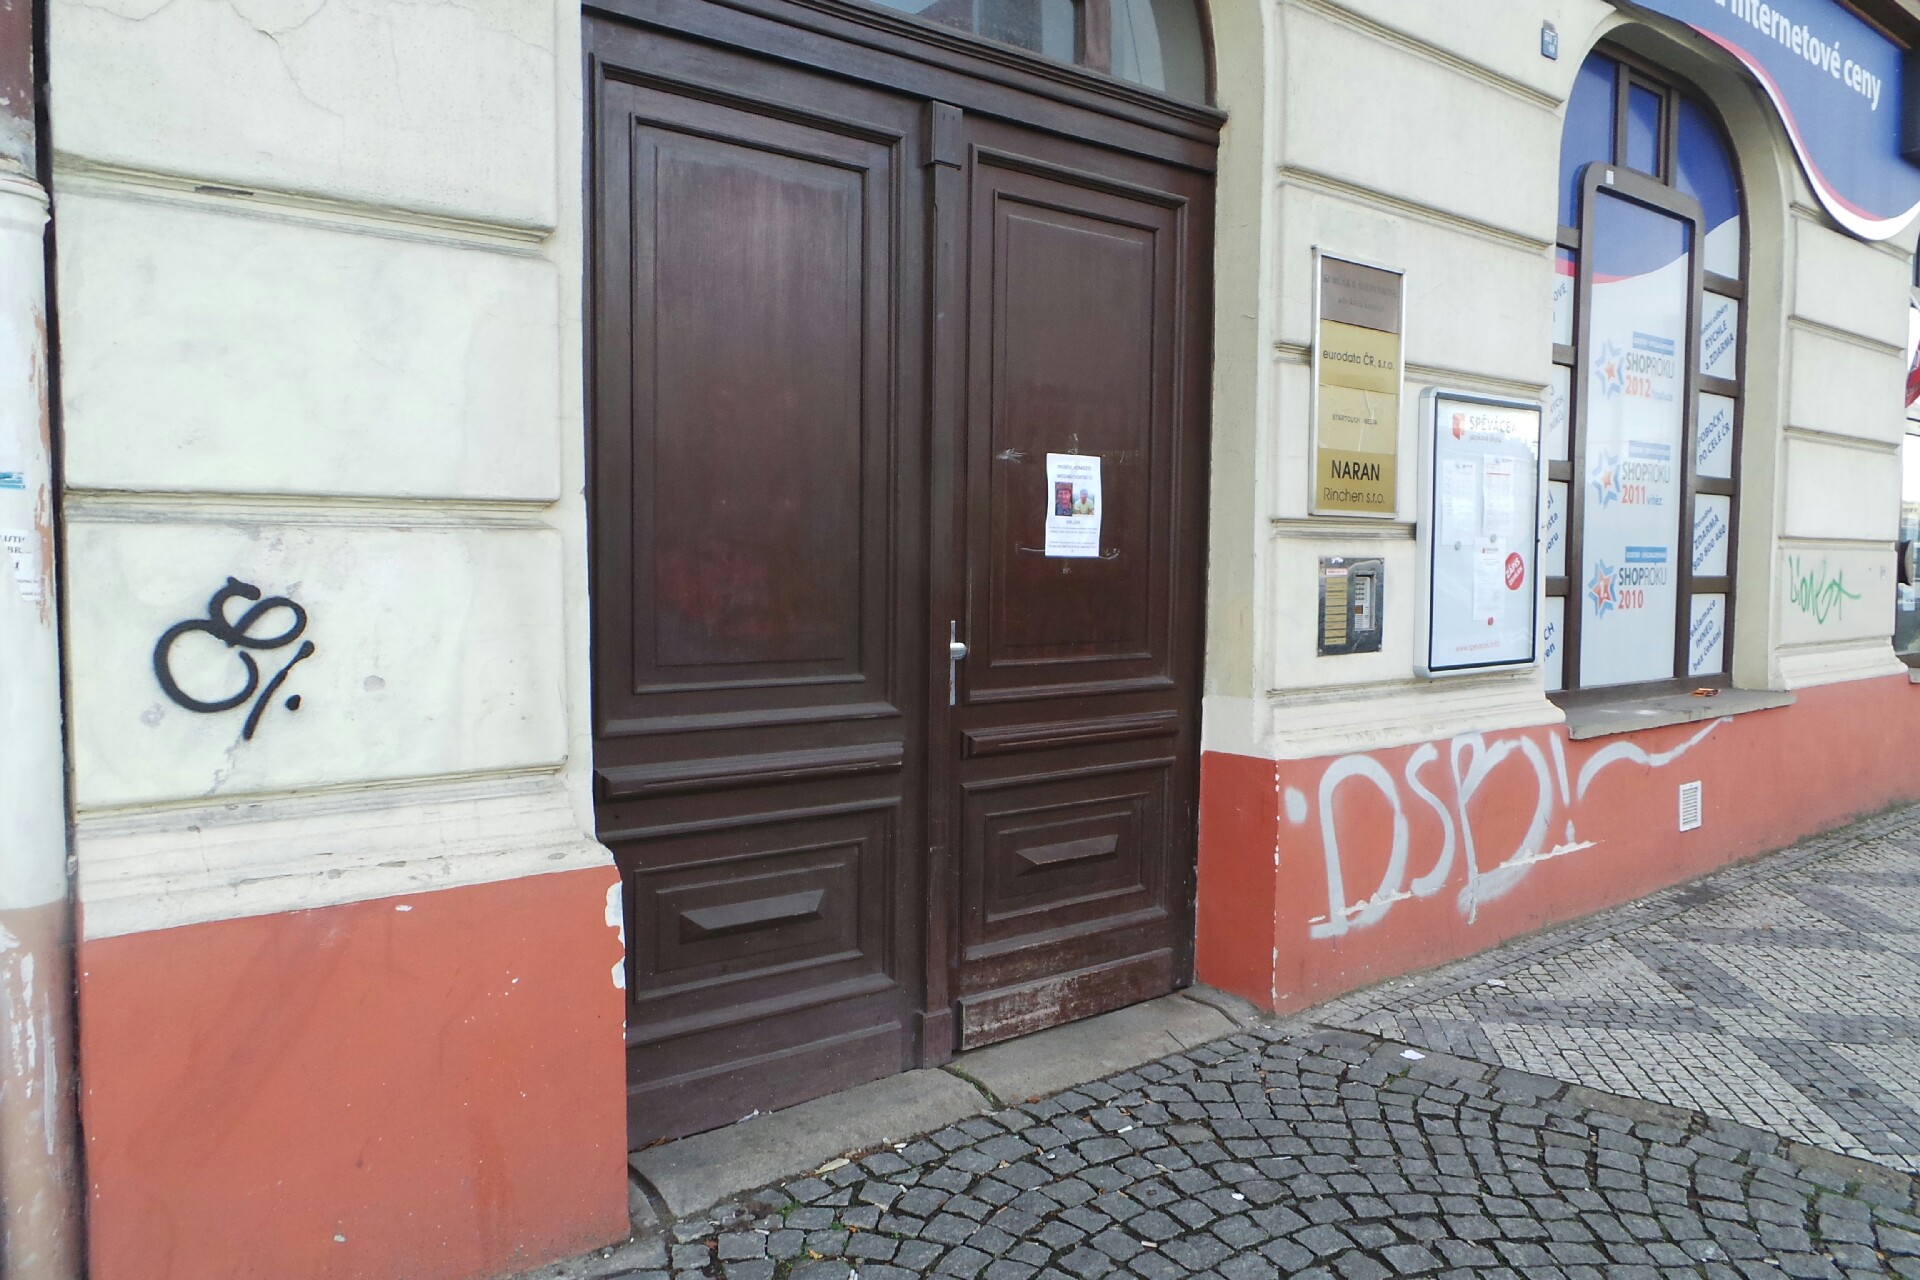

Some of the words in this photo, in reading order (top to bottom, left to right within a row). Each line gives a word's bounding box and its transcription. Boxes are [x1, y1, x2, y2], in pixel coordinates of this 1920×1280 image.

[1843, 59, 1882, 111] ceny
[1709, 333, 1734, 361] ZDARMA
[1322, 350, 1361, 365] eurodata
[1363, 352, 1376, 368] ČR,
[1377, 359, 1395, 370] s.r.o.
[1625, 375, 1651, 398] 2012
[1331, 459, 1380, 481] NARAN
[1323, 487, 1364, 503] Rinchen
[1366, 492, 1386, 504] s.r.o.
[1621, 484, 1646, 505] 2011
[1694, 514, 1719, 551] ZDARMA
[1618, 589, 1644, 610] 2010
[1690, 599, 1716, 637] eklamace
